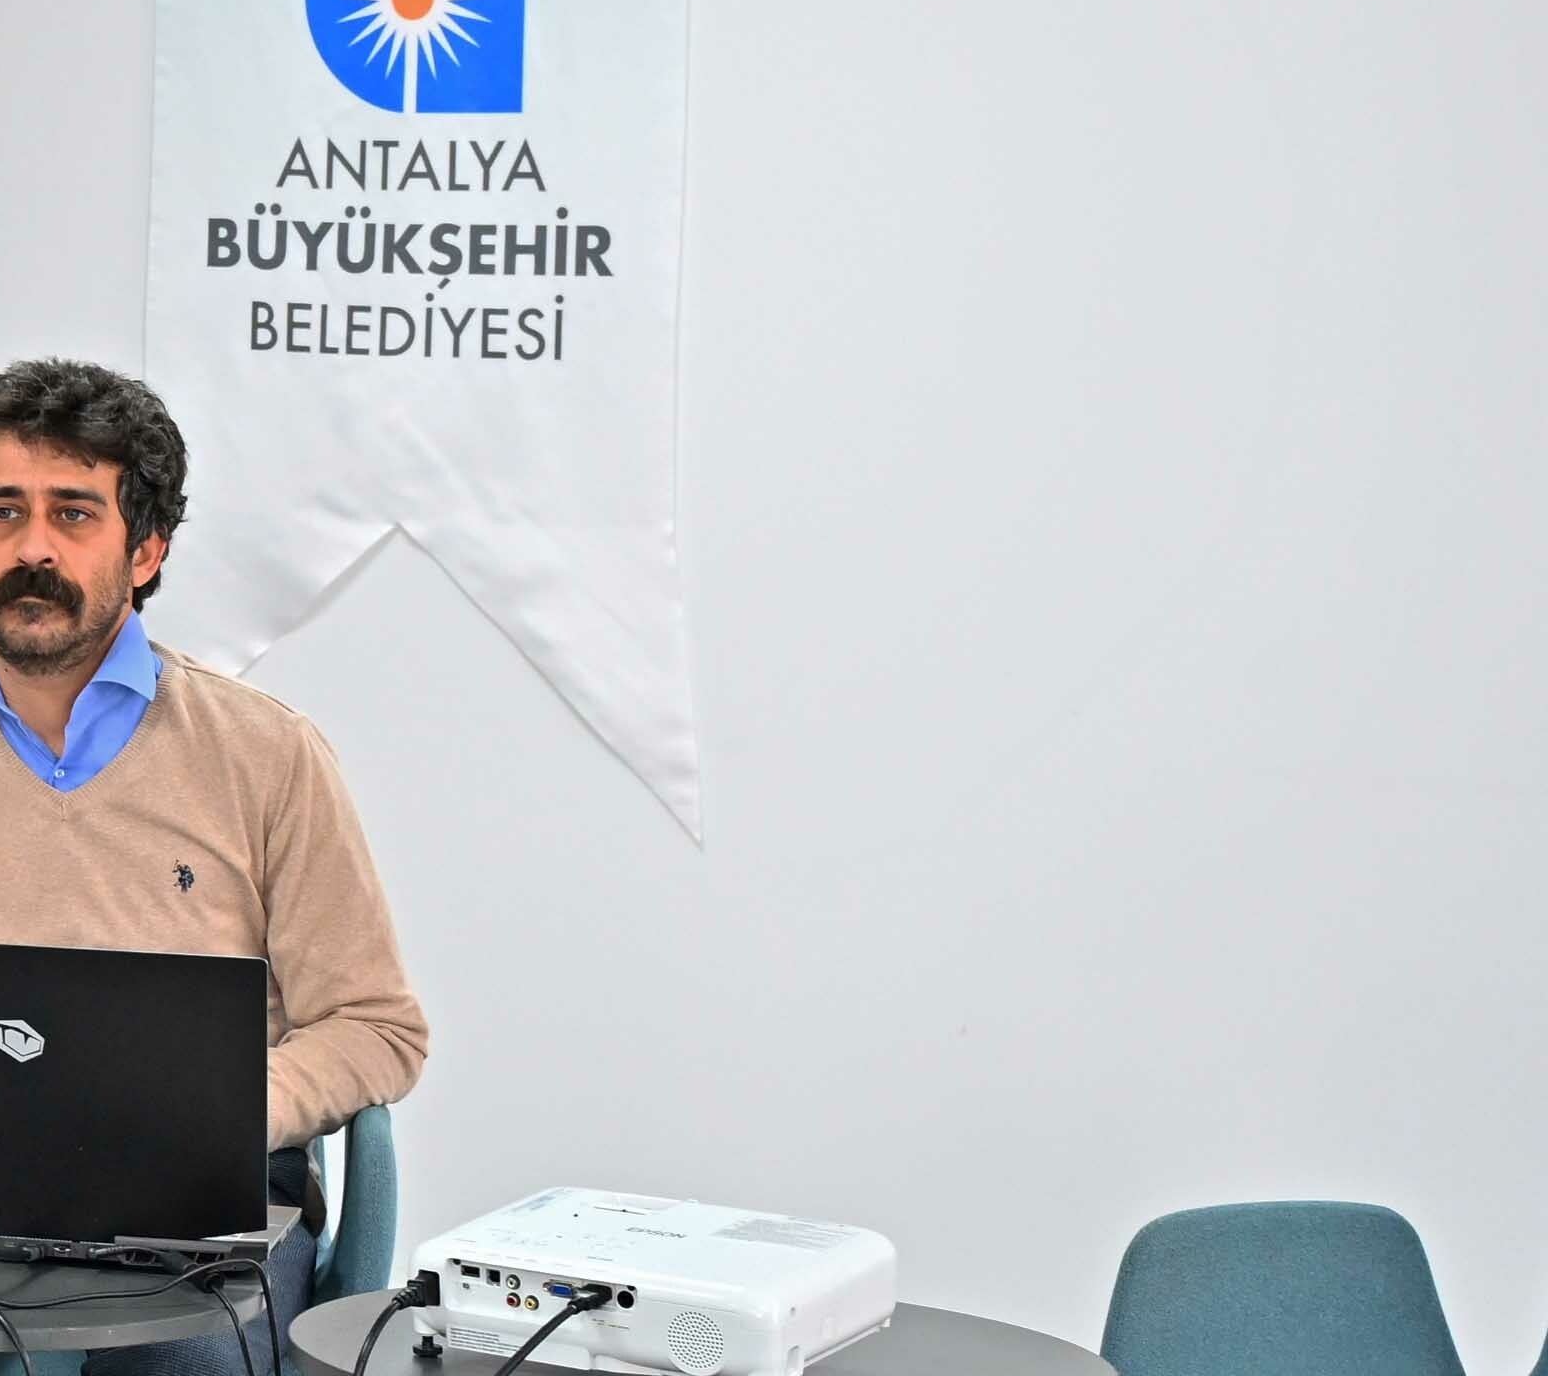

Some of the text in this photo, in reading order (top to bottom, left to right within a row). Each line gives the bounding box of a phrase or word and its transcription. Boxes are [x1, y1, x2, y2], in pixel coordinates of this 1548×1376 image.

[276, 137, 547, 192] ANTALYA
[206, 202, 614, 290] BÜYÜKŞEHİR
[250, 292, 564, 361] BELEDİYESİ
